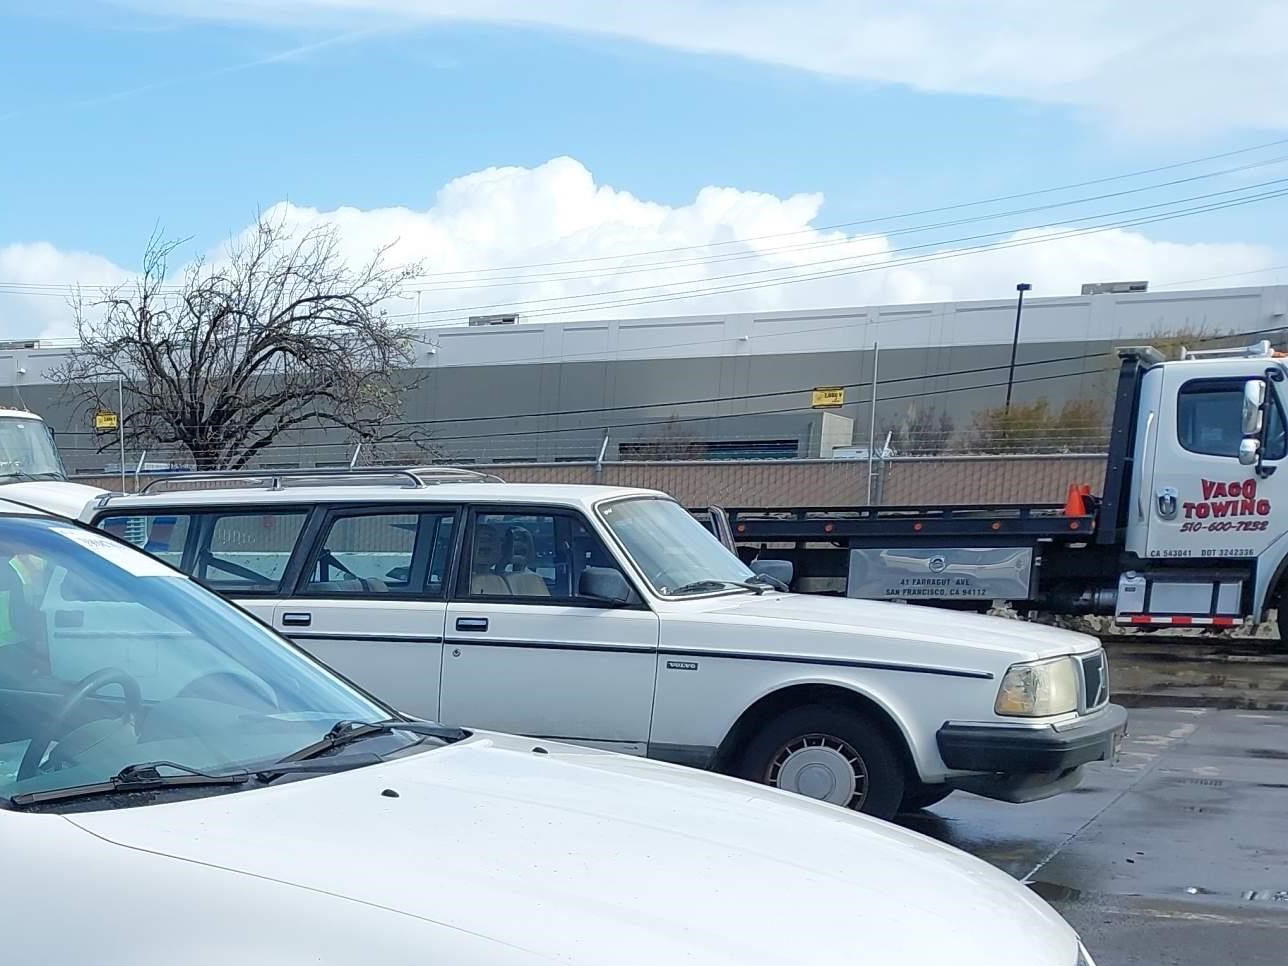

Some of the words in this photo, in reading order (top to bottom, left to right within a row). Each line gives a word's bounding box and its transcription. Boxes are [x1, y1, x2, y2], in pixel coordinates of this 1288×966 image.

[1182, 499, 1271, 519] TOWING
[1150, 549, 1161, 557] CA
[886, 588, 900, 596] SAN
[949, 588, 960, 596] CA
